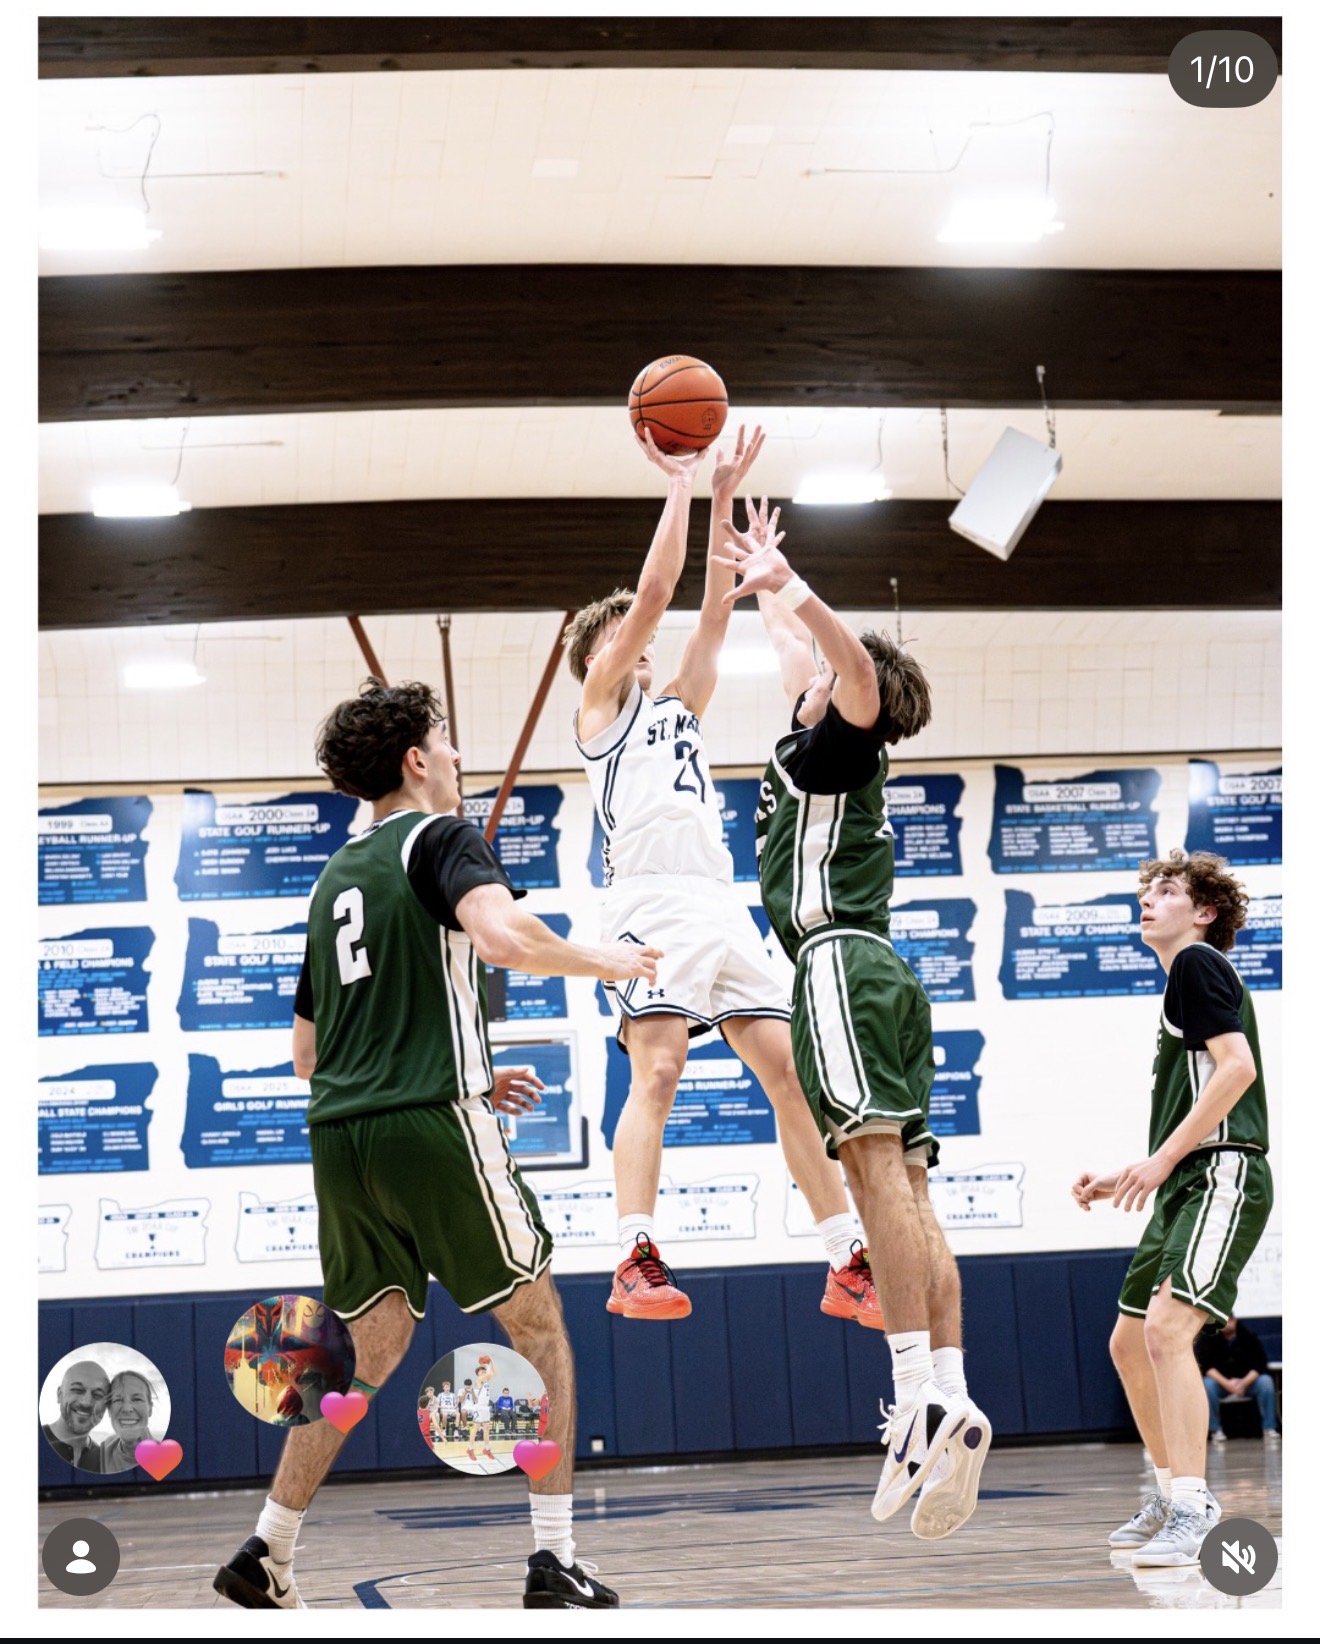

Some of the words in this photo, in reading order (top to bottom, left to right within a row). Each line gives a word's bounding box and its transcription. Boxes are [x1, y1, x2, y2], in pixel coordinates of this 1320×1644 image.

[647, 716, 671, 746] ST.
[673, 740, 706, 804] 21
[1251, 779, 1282, 790] 2007
[1028, 789, 1050, 797] OSAA
[1056, 787, 1084, 799] 2007
[1207, 797, 1237, 806] STATE
[1240, 795, 1267, 805] GOLF
[463, 801, 489, 813] 002
[887, 804, 946, 815] CHAMPIONS
[1005, 804, 1031, 814] STATE
[1033, 802, 1087, 813] BASKETBALL
[1089, 801, 1141, 811] RUNNER-UP
[249, 809, 284, 821] 2000
[482, 814, 545, 826] RNNER-UP
[48, 820, 74, 829] 1999
[199, 827, 230, 838] STATE
[234, 825, 265, 836] GOLF
[266, 822, 331, 835] RUNNER-UP
[79, 832, 138, 844] RUNNER-UP
[1065, 909, 1098, 922] 2009
[333, 886, 372, 986] 2
[908, 927, 960, 939] CHAMPIONS
[1020, 927, 1051, 938] STATE
[1054, 926, 1083, 936] GOLF
[1085, 923, 1141, 935] CHAMPION
[43, 944, 74, 956] 2010
[253, 938, 286, 950] 2010
[53, 959, 79, 969] FIELD
[81, 957, 134, 968] CHAMPIONS
[203, 955, 237, 967] STATE
[239, 954, 270, 966] GOLF
[695, 1079, 752, 1090] RUNNER-UP
[57, 1107, 86, 1117] STATE
[87, 1104, 143, 1117] CHAMPIONS
[213, 1101, 245, 1112] GIRLS
[246, 1100, 274, 1111] GOLF
[946, 1212, 998, 1220] CHAMPIONS
[125, 1250, 180, 1259] CHAMPIONS
